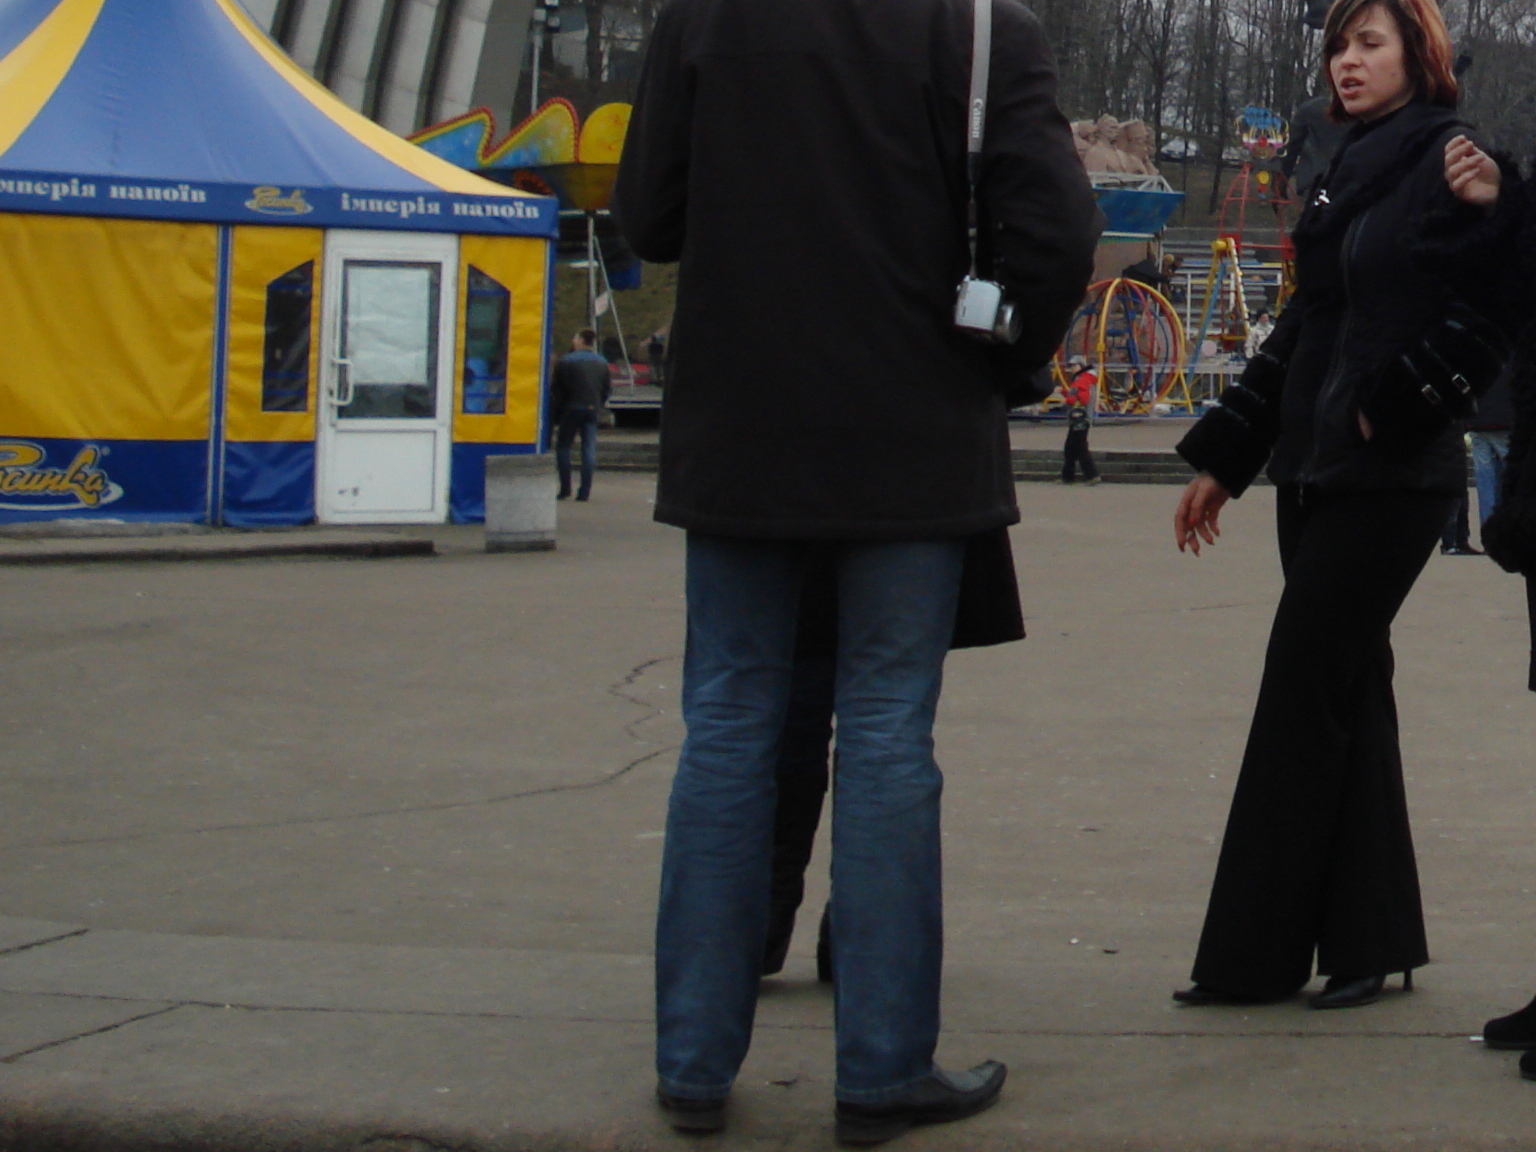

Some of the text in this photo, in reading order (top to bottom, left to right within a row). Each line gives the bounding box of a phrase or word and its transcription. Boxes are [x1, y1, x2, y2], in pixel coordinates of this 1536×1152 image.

[0, 178, 206, 203] мперія напоїв
[453, 201, 539, 219] напоїв
